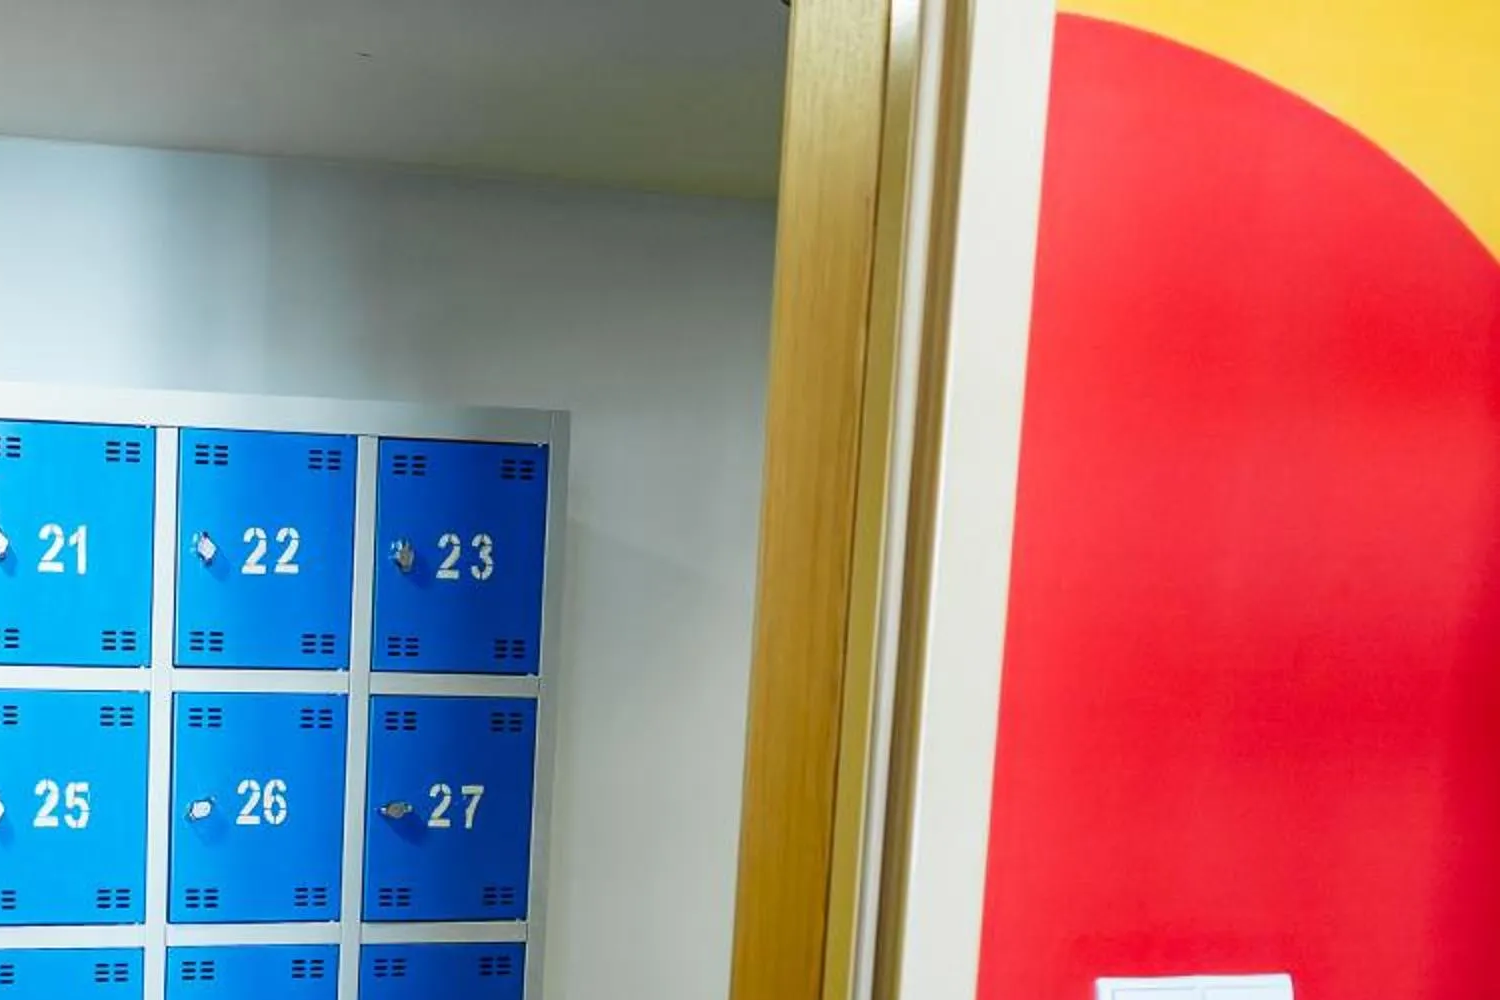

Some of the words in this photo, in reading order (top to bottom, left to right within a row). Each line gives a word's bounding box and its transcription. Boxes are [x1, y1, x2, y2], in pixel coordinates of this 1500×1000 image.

[37, 524, 87, 575] 21
[241, 527, 299, 575] 22
[436, 534, 493, 580] 23
[33, 779, 90, 829] 25
[236, 779, 287, 825] 26
[427, 783, 484, 829] 27
